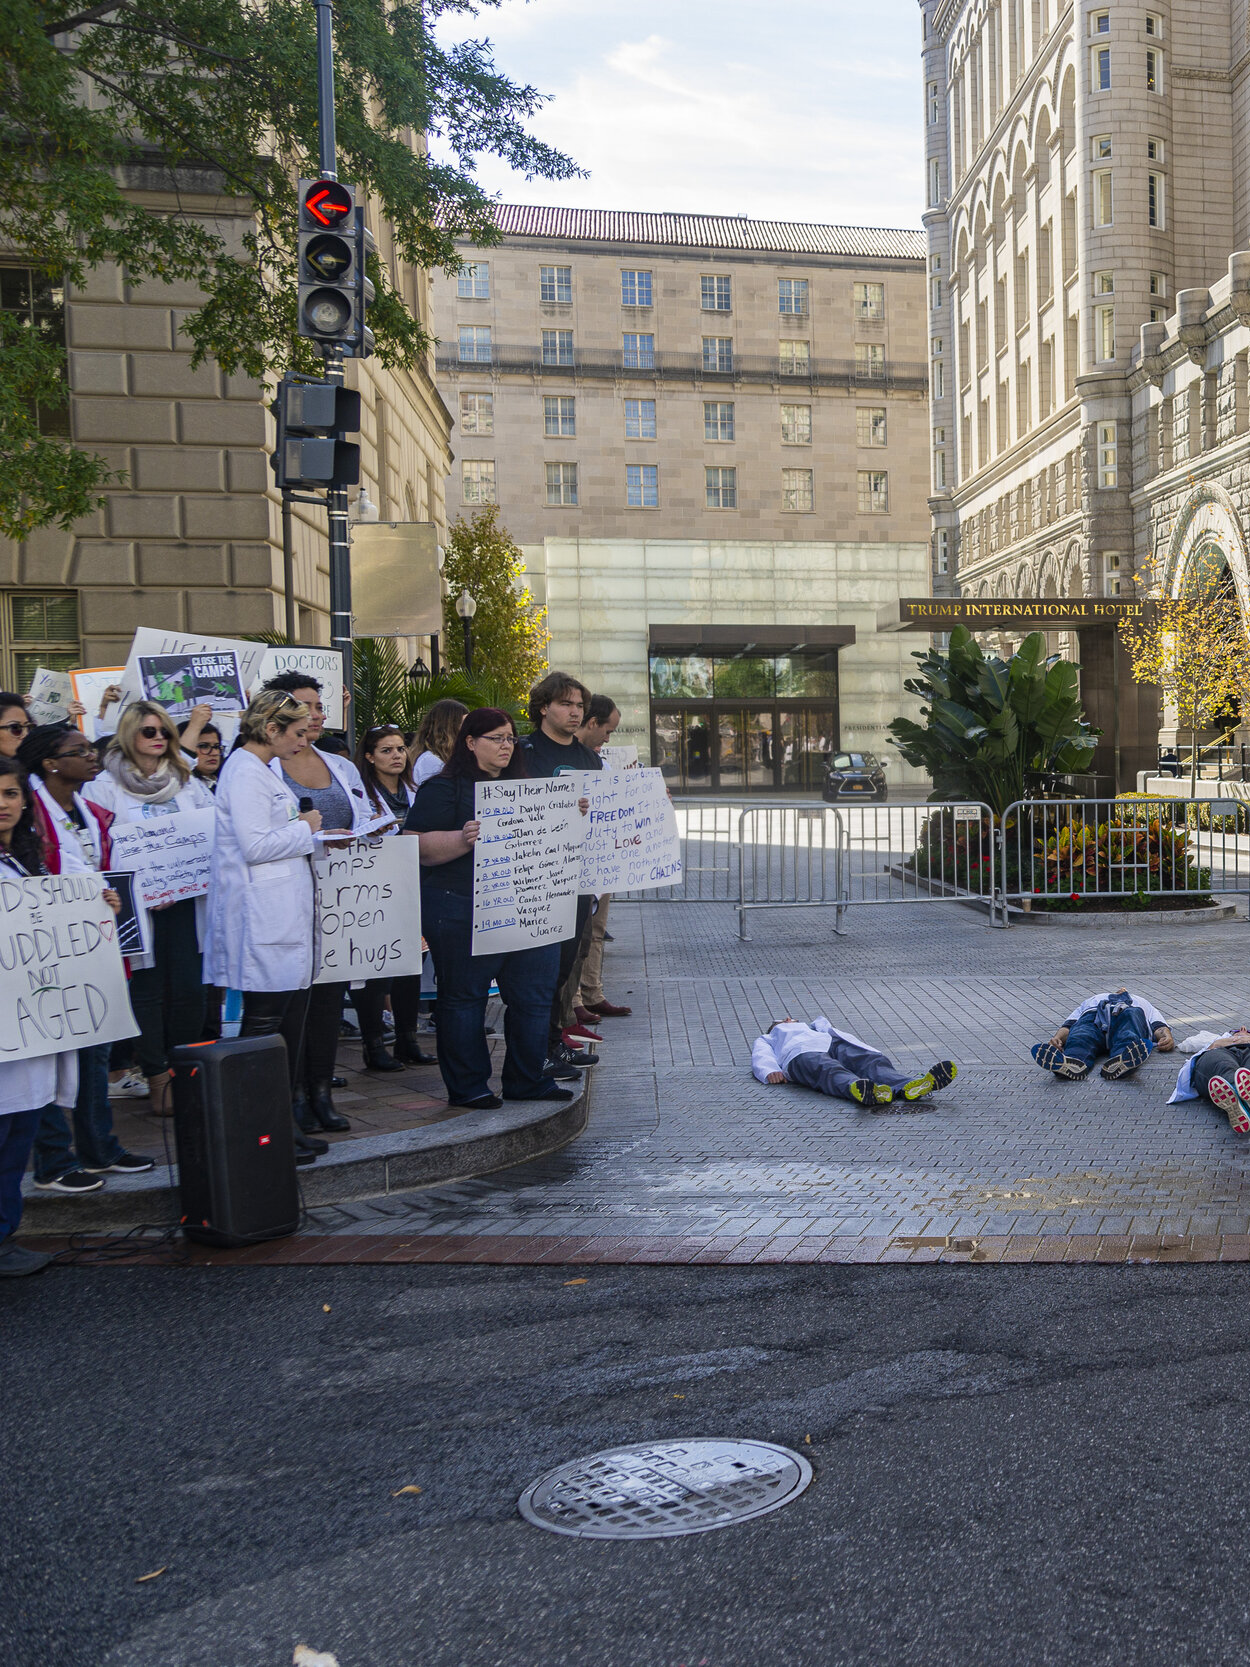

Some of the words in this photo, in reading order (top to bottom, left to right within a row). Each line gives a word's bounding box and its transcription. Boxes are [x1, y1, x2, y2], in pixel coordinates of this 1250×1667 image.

[906, 604, 962, 616] TRUMP
[966, 604, 1089, 616] INTERNATIONAL
[1093, 604, 1143, 616] HOTEL
[191, 655, 217, 666] CLOSE
[216, 655, 234, 664] THE
[274, 654, 338, 671] DOCTORS
[193, 663, 236, 679] CAMPS
[584, 790, 618, 810] ight
[482, 806, 491, 815] 10
[502, 806, 515, 815] OLD
[590, 806, 635, 824] FREEDOM
[536, 826, 547, 836] de
[585, 824, 617, 840] duty
[622, 821, 633, 832] to
[646, 826, 664, 839] and
[119, 845, 142, 858] lose
[143, 840, 164, 852] the
[164, 832, 209, 849] Camps
[348, 837, 384, 855] the
[316, 855, 377, 879] mps
[482, 858, 490, 866] 7
[597, 864, 621, 876] have
[482, 872, 489, 880] 8
[491, 870, 500, 878] YR
[500, 868, 512, 876] OLD
[580, 879, 597, 889] ose
[603, 875, 619, 886] but
[650, 859, 682, 881] CHAINS
[0, 879, 41, 913] DS
[41, 877, 100, 906] SHOULD
[482, 899, 491, 907] 16
[493, 897, 502, 905] YR
[518, 895, 543, 904] Carlos
[29, 912, 43, 925] BE
[516, 904, 552, 917] Vasquez
[481, 919, 491, 929] 19
[531, 925, 564, 938] Juarez
[0, 920, 101, 971] UDDLED
[350, 938, 402, 972] hugs
[27, 963, 61, 991] NOT
[0, 983, 109, 1052] AGED
